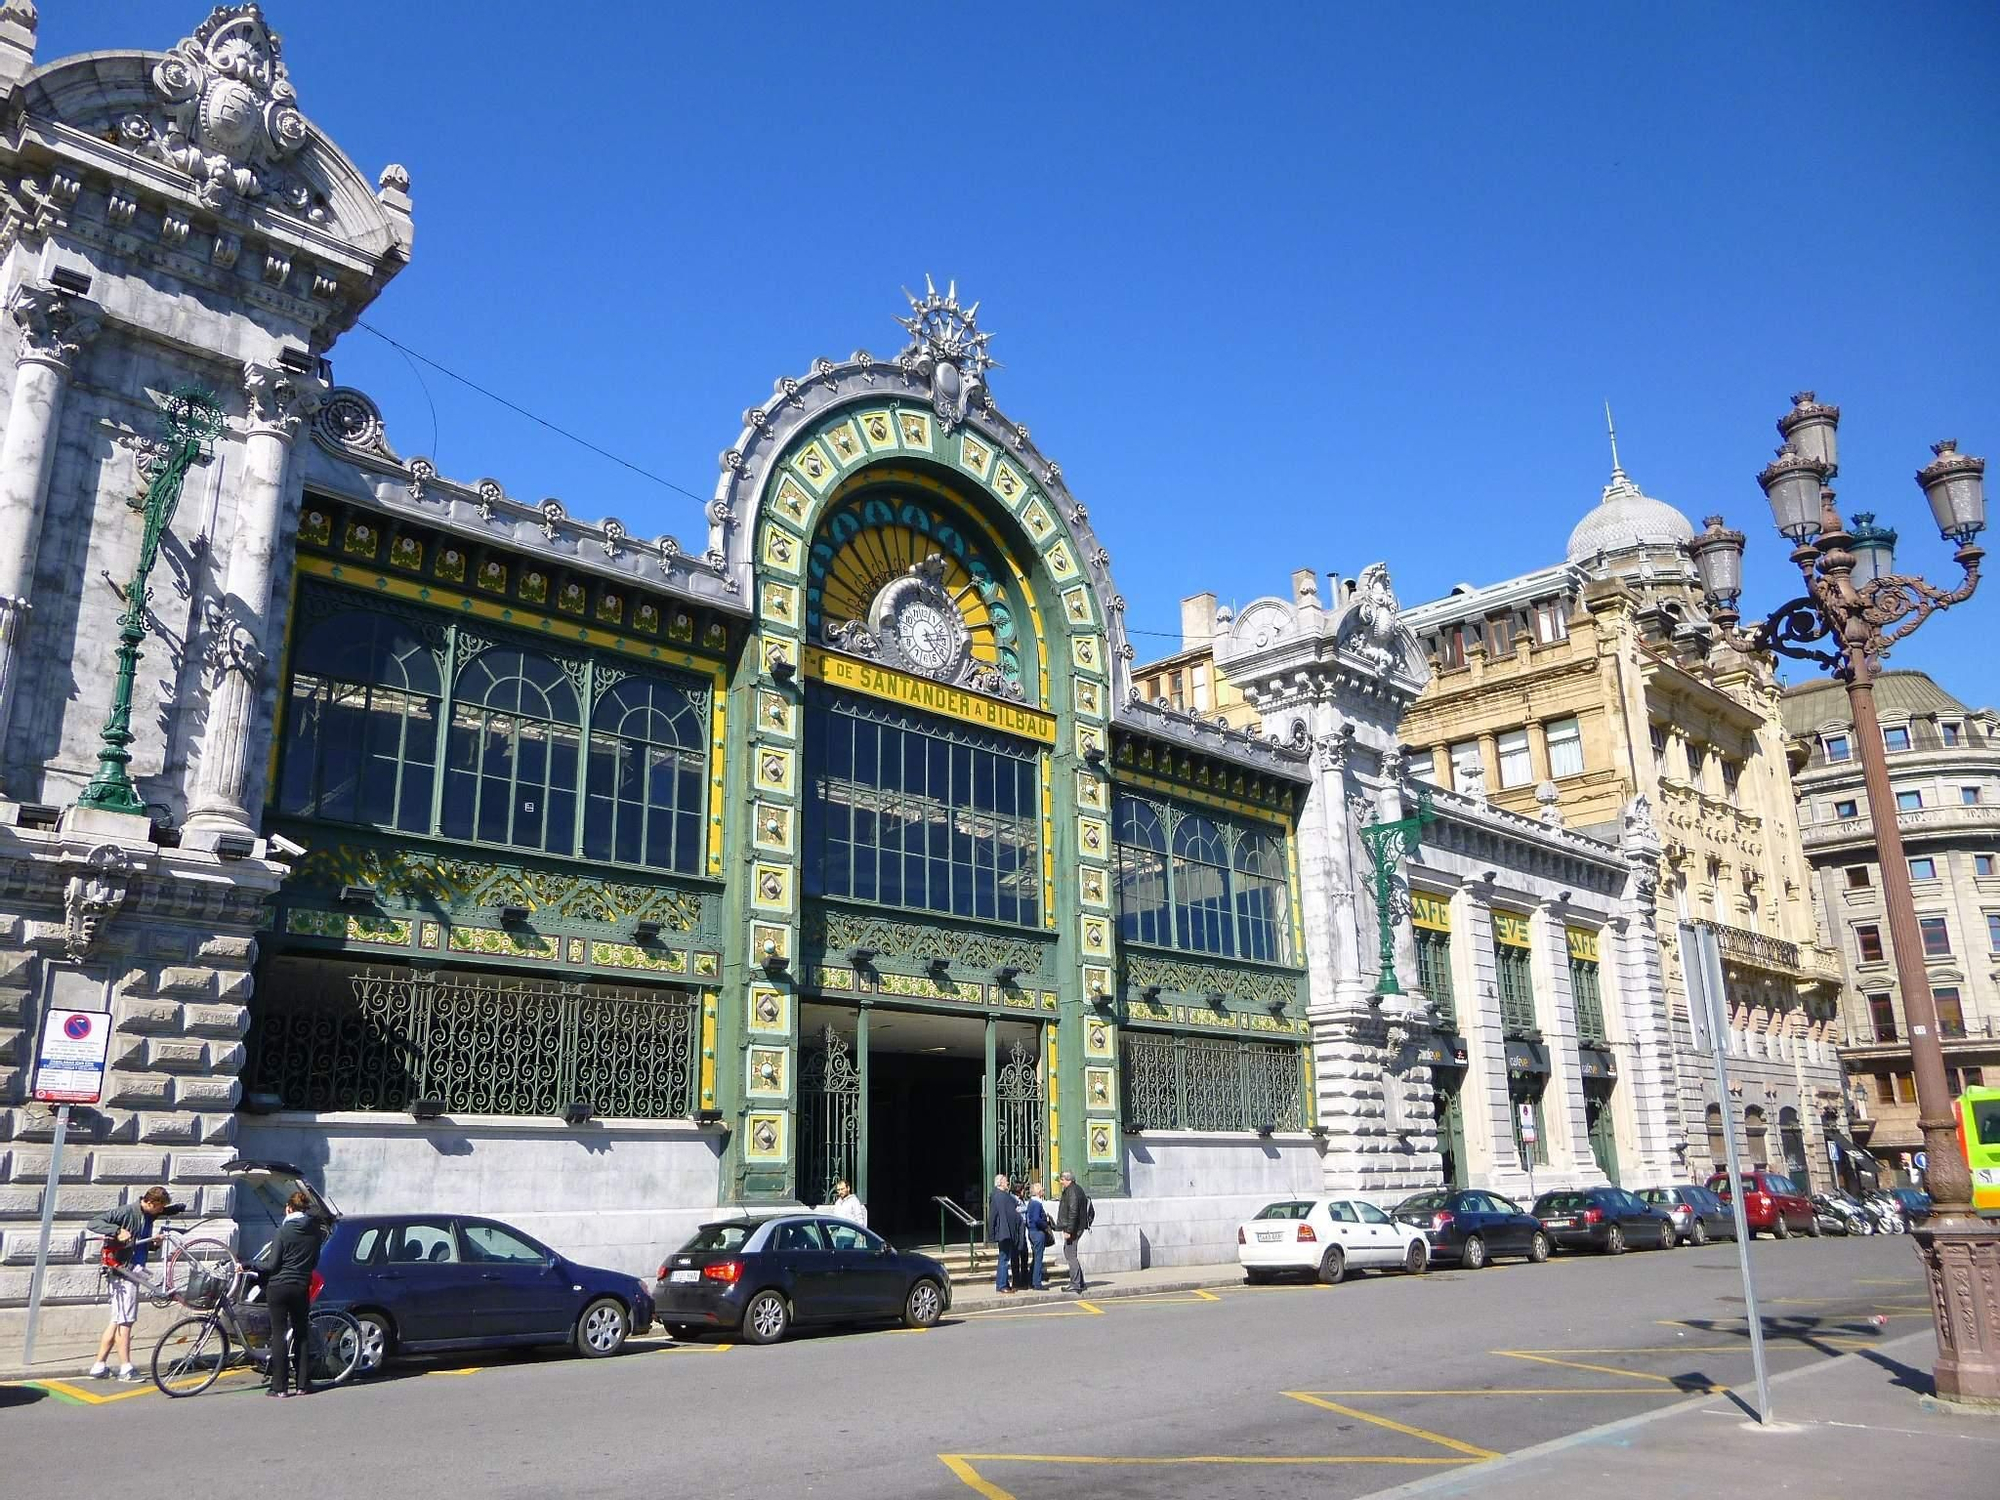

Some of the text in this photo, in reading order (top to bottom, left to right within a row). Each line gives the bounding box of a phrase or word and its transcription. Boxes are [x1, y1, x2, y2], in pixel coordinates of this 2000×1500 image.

[836, 662, 853, 680] DE
[860, 665, 970, 716] SANTANDER
[975, 702, 982, 717] A
[987, 702, 1048, 737] BILBAO
[1413, 897, 1449, 926] AFE
[1571, 931, 1598, 957] AFE
